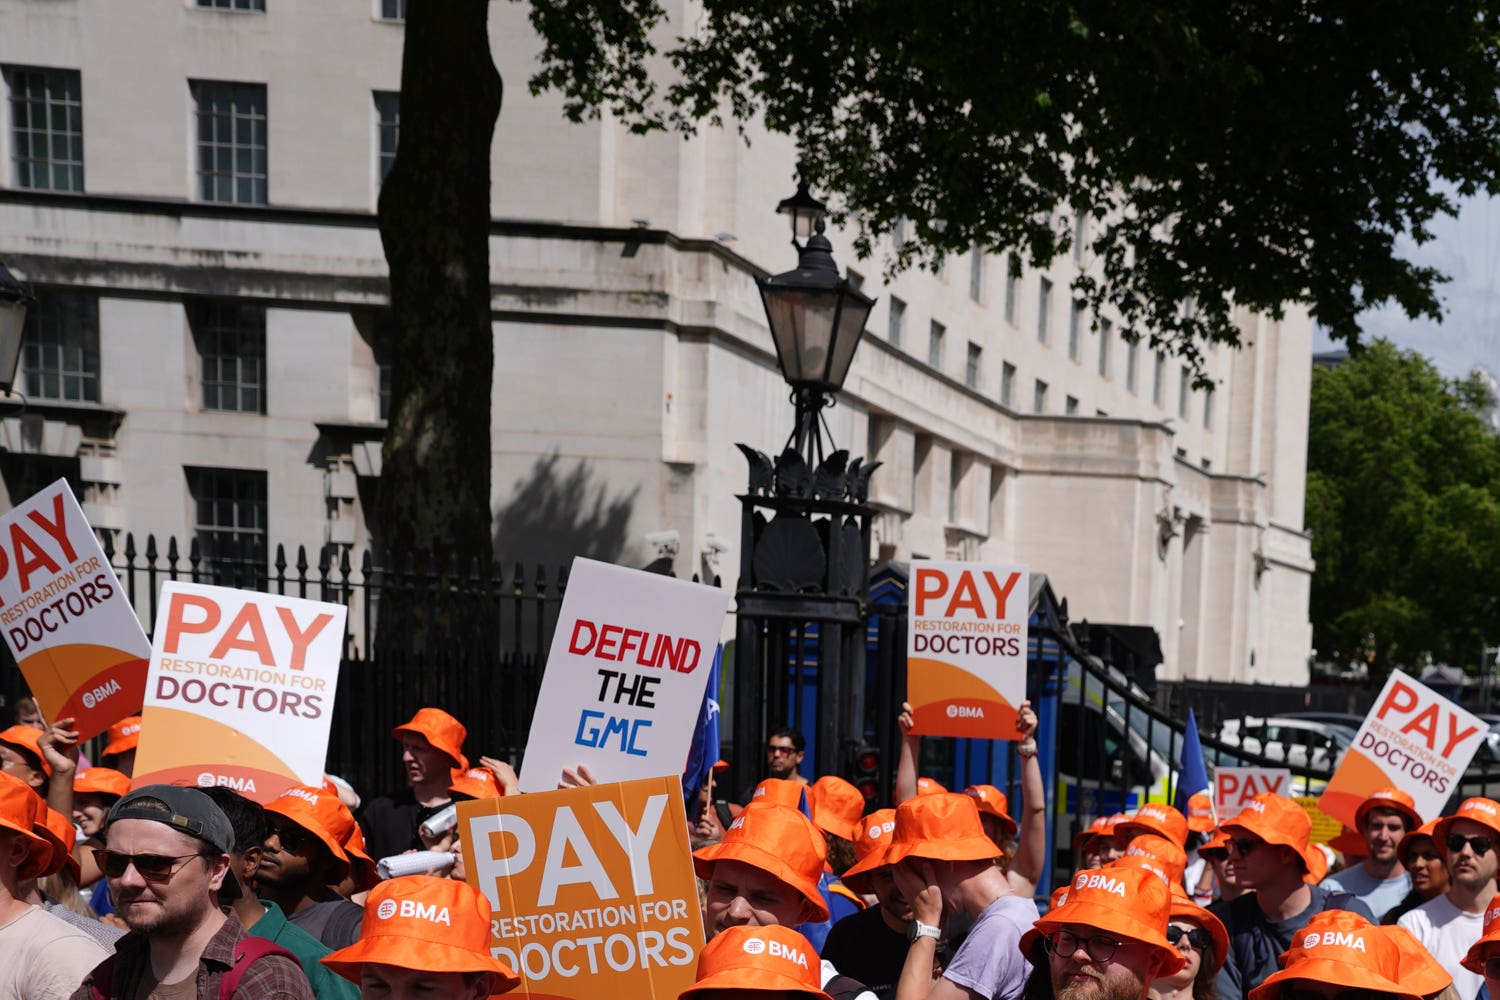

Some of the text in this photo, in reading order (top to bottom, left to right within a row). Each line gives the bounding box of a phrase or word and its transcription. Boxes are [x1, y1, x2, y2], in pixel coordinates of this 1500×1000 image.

[1, 556, 101, 626] RESTORATION FOR
[915, 568, 1021, 620] PAY
[9, 574, 113, 652] DOCTORS
[163, 592, 334, 671] PAY
[914, 620, 1021, 634] RESTORATION FOR
[568, 618, 702, 674] DEFUND
[914, 634, 1019, 656] DOCTORS
[94, 679, 121, 703] BMA
[160, 658, 326, 692] RESTORATION FOR
[597, 669, 661, 709] THE
[156, 675, 321, 720] DOCTORS
[959, 707, 984, 718] BMA
[575, 709, 652, 757] GMC
[1376, 680, 1478, 760] PAY
[1359, 732, 1450, 795] DOCTORS
[1369, 721, 1458, 777] RESTORATION FOR
[216, 776, 256, 793] BMA
[1218, 774, 1283, 807] PAY
[469, 794, 669, 912] PAY
[1087, 875, 1126, 897] BMA
[399, 899, 452, 928] BMA
[491, 899, 688, 938] RESTORATION FOR
[492, 927, 694, 981] DOCTORS
[768, 940, 808, 970] BMA
[1322, 931, 1366, 953] BMA
